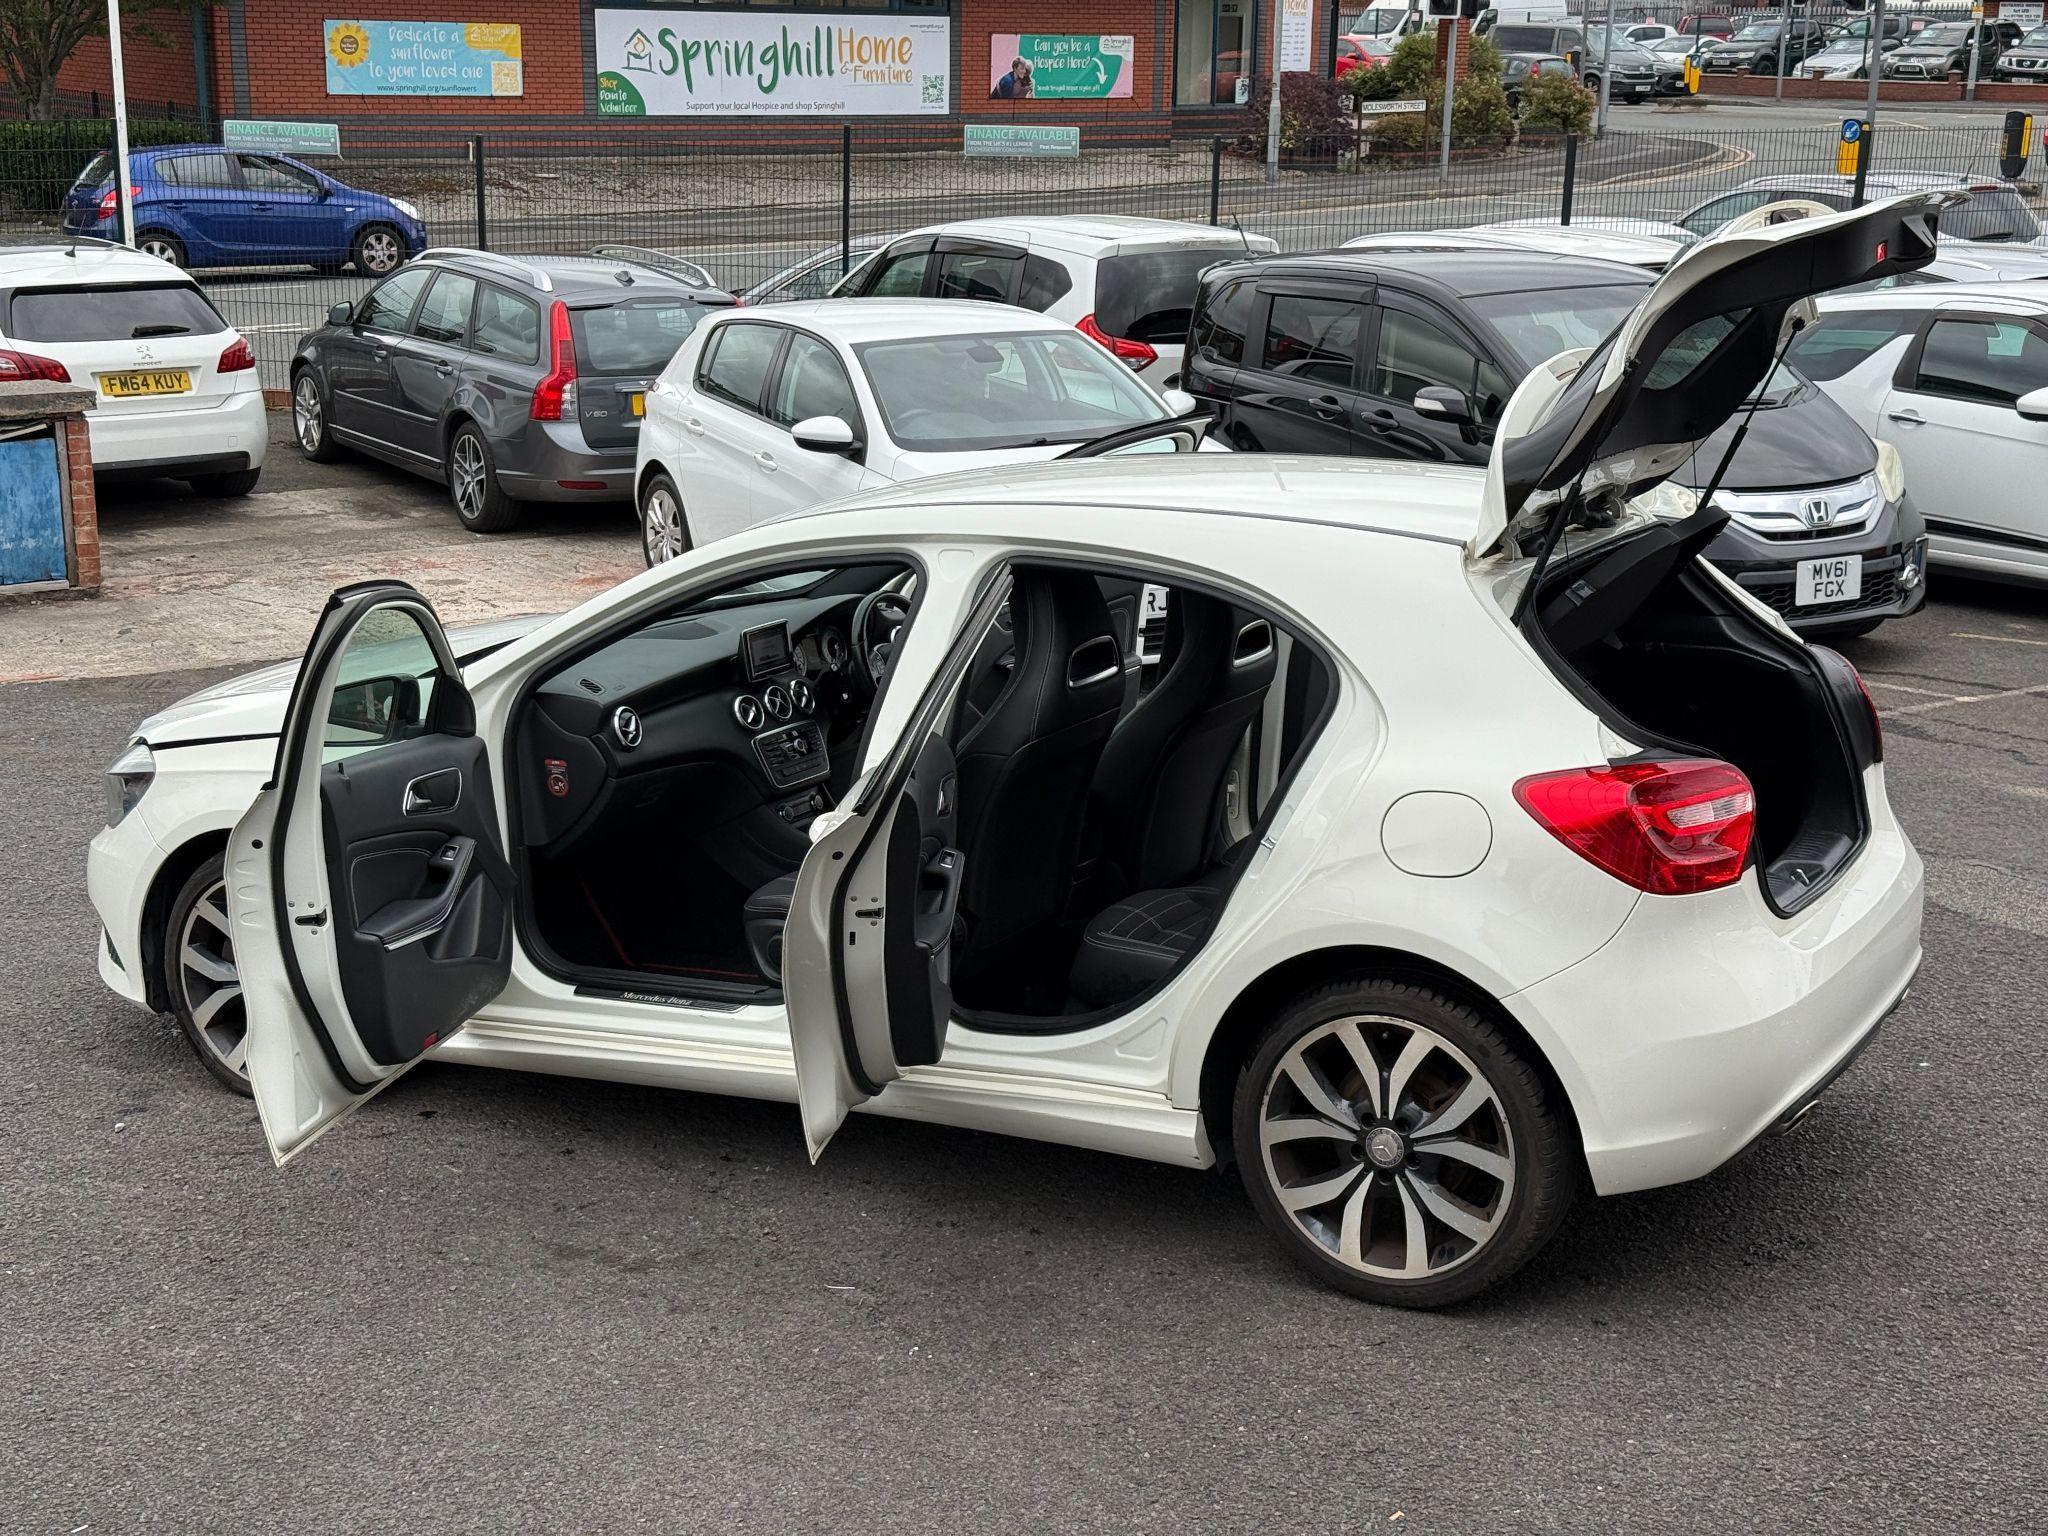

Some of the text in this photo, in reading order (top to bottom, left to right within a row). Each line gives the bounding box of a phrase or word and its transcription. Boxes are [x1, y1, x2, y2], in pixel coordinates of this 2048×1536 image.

[388, 26, 460, 43] Dedicate a
[390, 43, 455, 60] sunflower
[1034, 38, 1091, 56] Can you be a
[658, 25, 912, 94] Springhill Home
[1035, 56, 1065, 72] Hospice
[368, 60, 483, 83] to your loved one
[840, 61, 913, 84] & Furniture
[377, 84, 477, 93] www.springhill.org/sunflowers
[600, 77, 618, 90] Shop
[600, 89, 628, 101] Donate
[600, 101, 638, 113] Volunteer
[686, 101, 715, 112] Support
[716, 103, 732, 111] your
[733, 101, 750, 110] local
[752, 101, 779, 111] Hospice
[795, 102, 812, 111] shop
[813, 102, 846, 111] Springhill
[1363, 102, 1425, 111] MOLESWORTH STREET
[226, 123, 336, 138] FINANCE AVAILABLE
[967, 128, 1077, 141] FINANCE AVAILABLE
[107, 373, 183, 392] FM64 KUY
[1813, 560, 1847, 580] MV61
[1814, 580, 1844, 599] FGX
[621, 991, 692, 1005] Mercedes Benz
